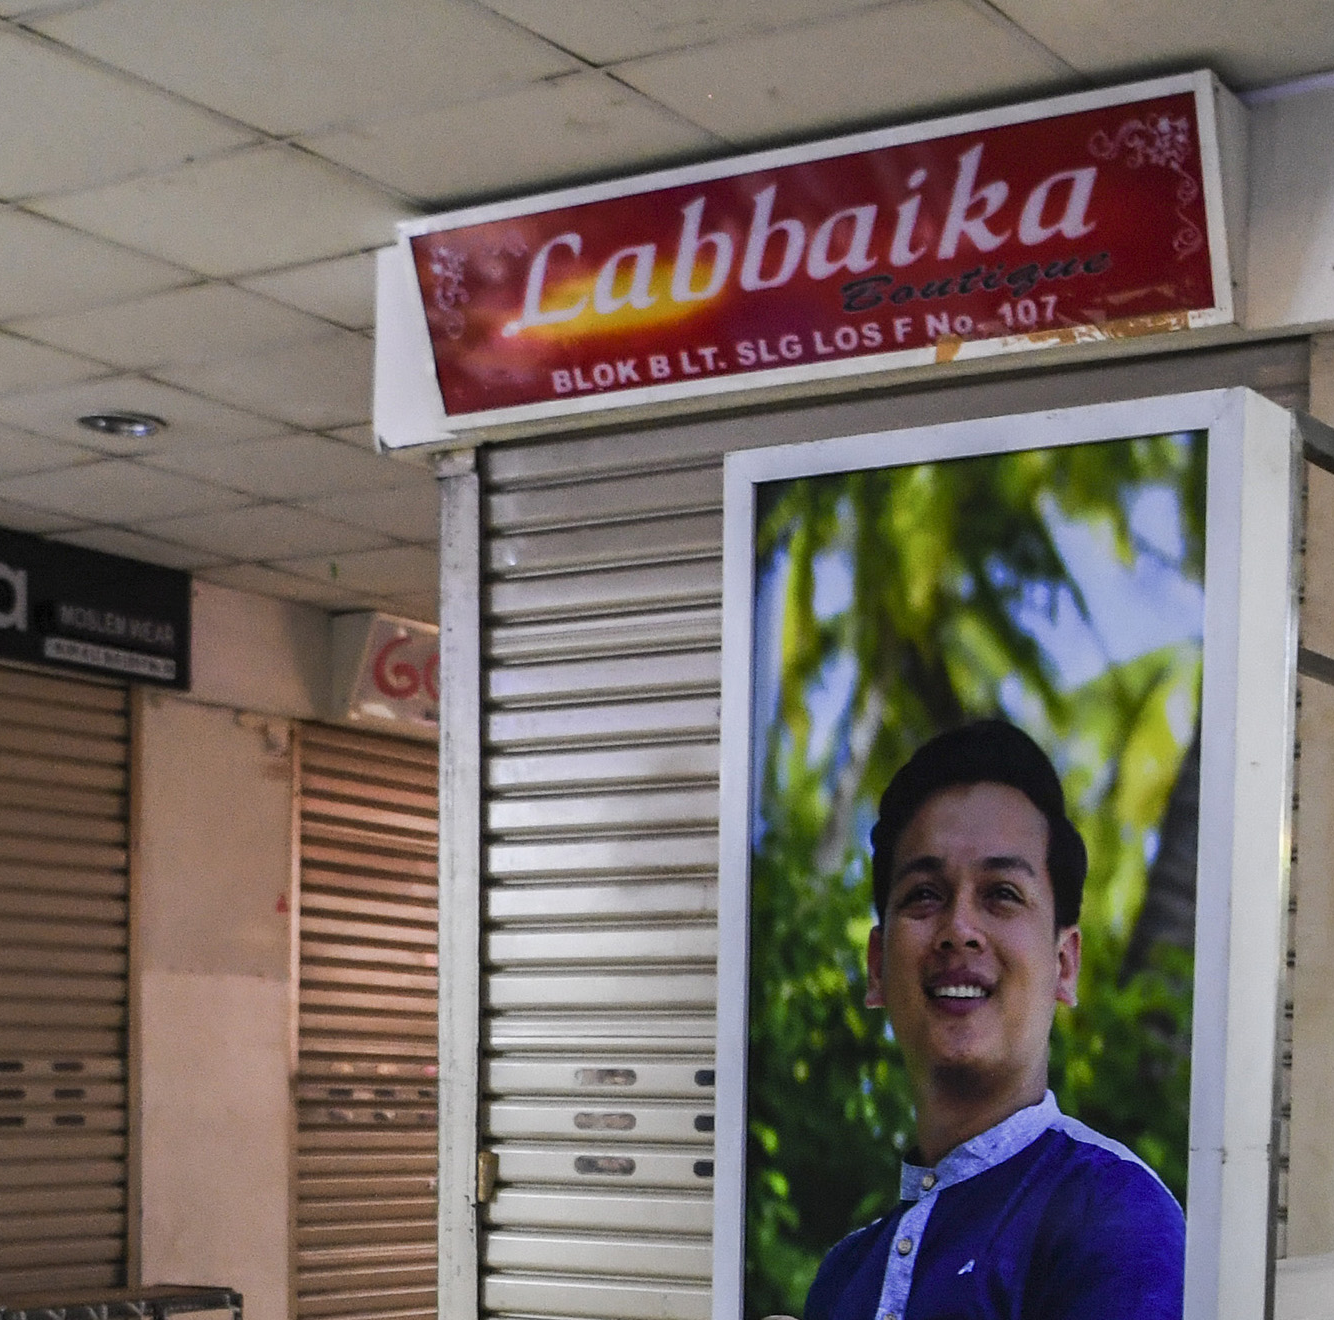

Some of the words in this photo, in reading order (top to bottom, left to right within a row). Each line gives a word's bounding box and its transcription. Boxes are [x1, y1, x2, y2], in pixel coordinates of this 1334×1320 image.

[501, 142, 1098, 338] Labbaika
[840, 251, 1111, 314] Boutique
[551, 359, 641, 394] BLOK
[649, 354, 671, 380] B
[680, 346, 728, 374] LT.
[736, 334, 803, 367] SLG
[813, 320, 884, 355] LOS
[892, 317, 913, 343] F
[997, 295, 1059, 328] 107
